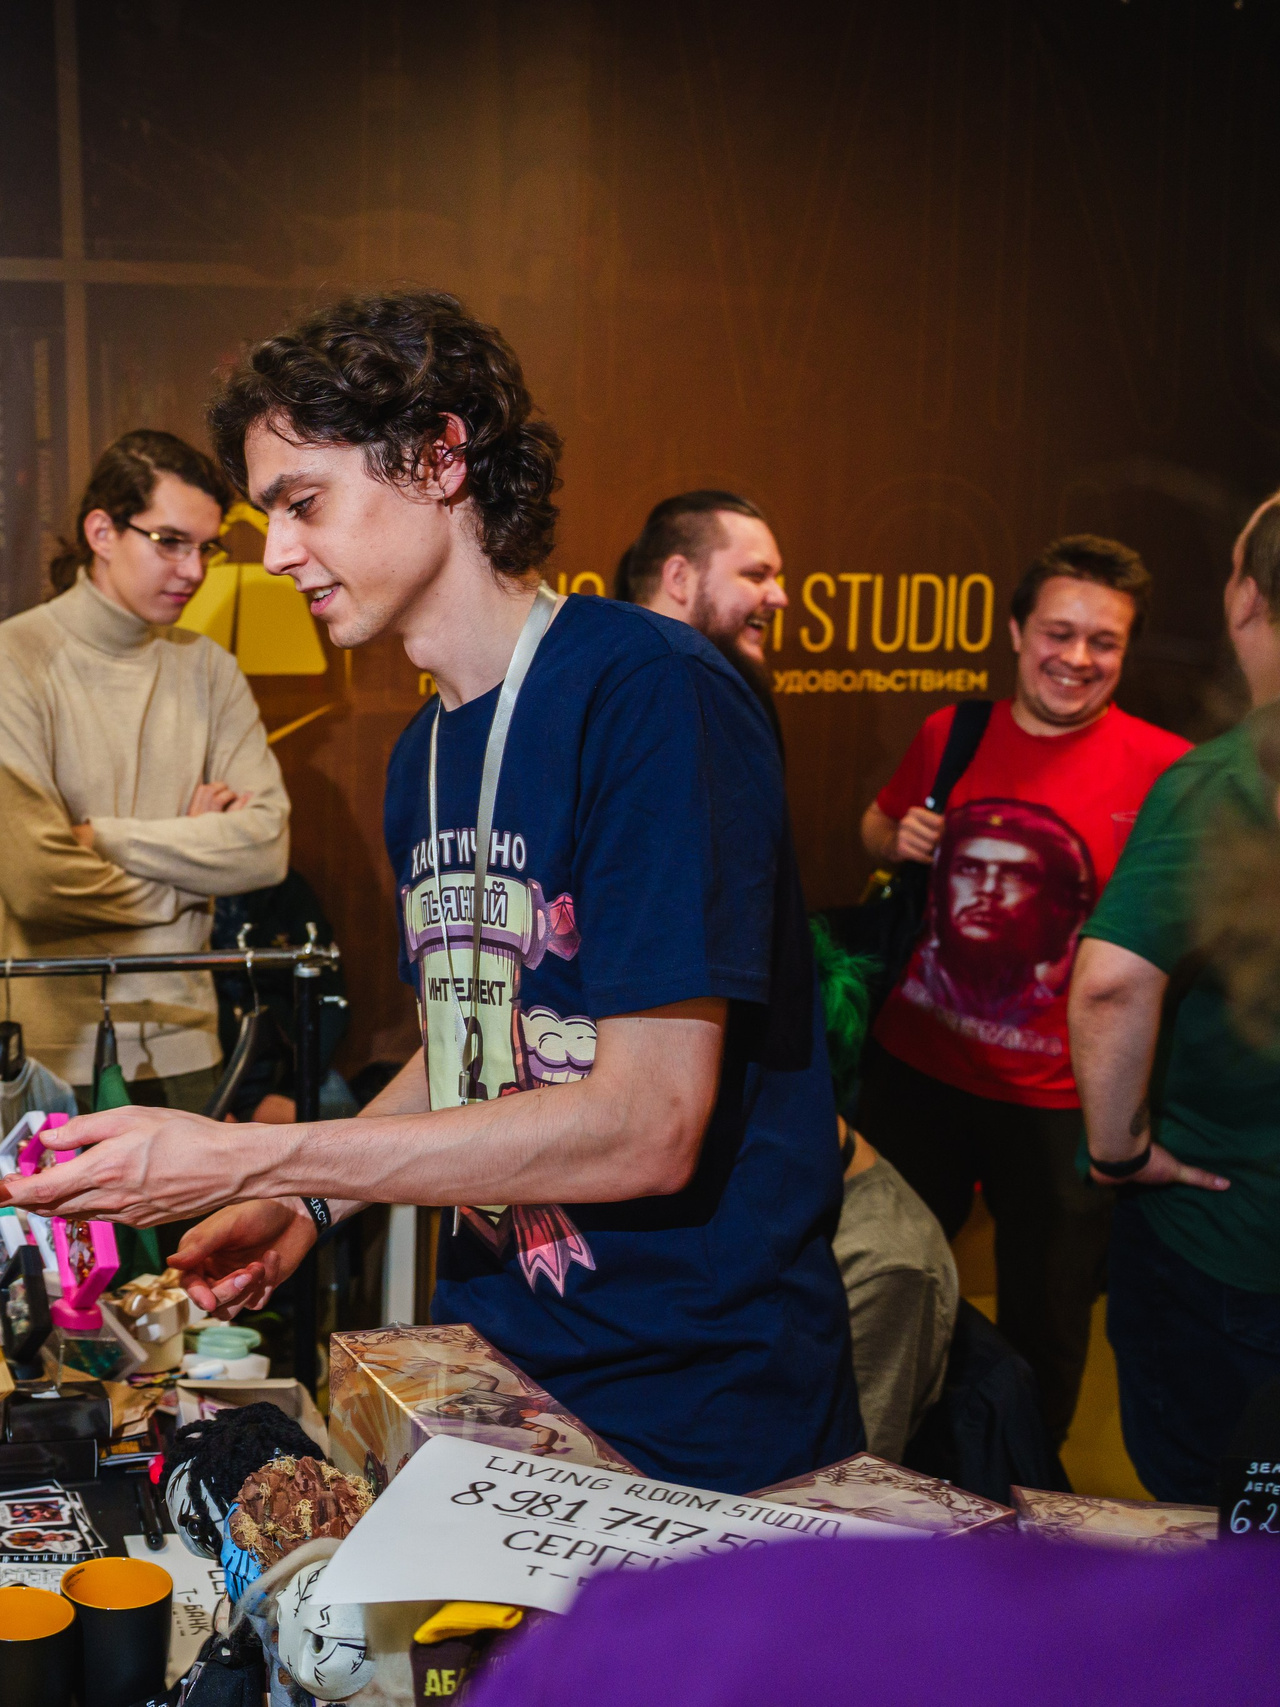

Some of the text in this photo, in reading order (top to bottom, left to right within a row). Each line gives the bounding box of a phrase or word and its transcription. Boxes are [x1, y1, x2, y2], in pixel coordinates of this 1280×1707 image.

[799, 572, 995, 652] STUDIO
[773, 668, 988, 694] УДОВОЛЬСТВИЕМ
[451, 1481, 497, 1506] 8
[493, 1490, 589, 1524] 981
[598, 1506, 709, 1545] 747
[485, 1455, 841, 1540] LIVING ROOM STUDIO
[177, 1588, 211, 1636] Т-БАНК
